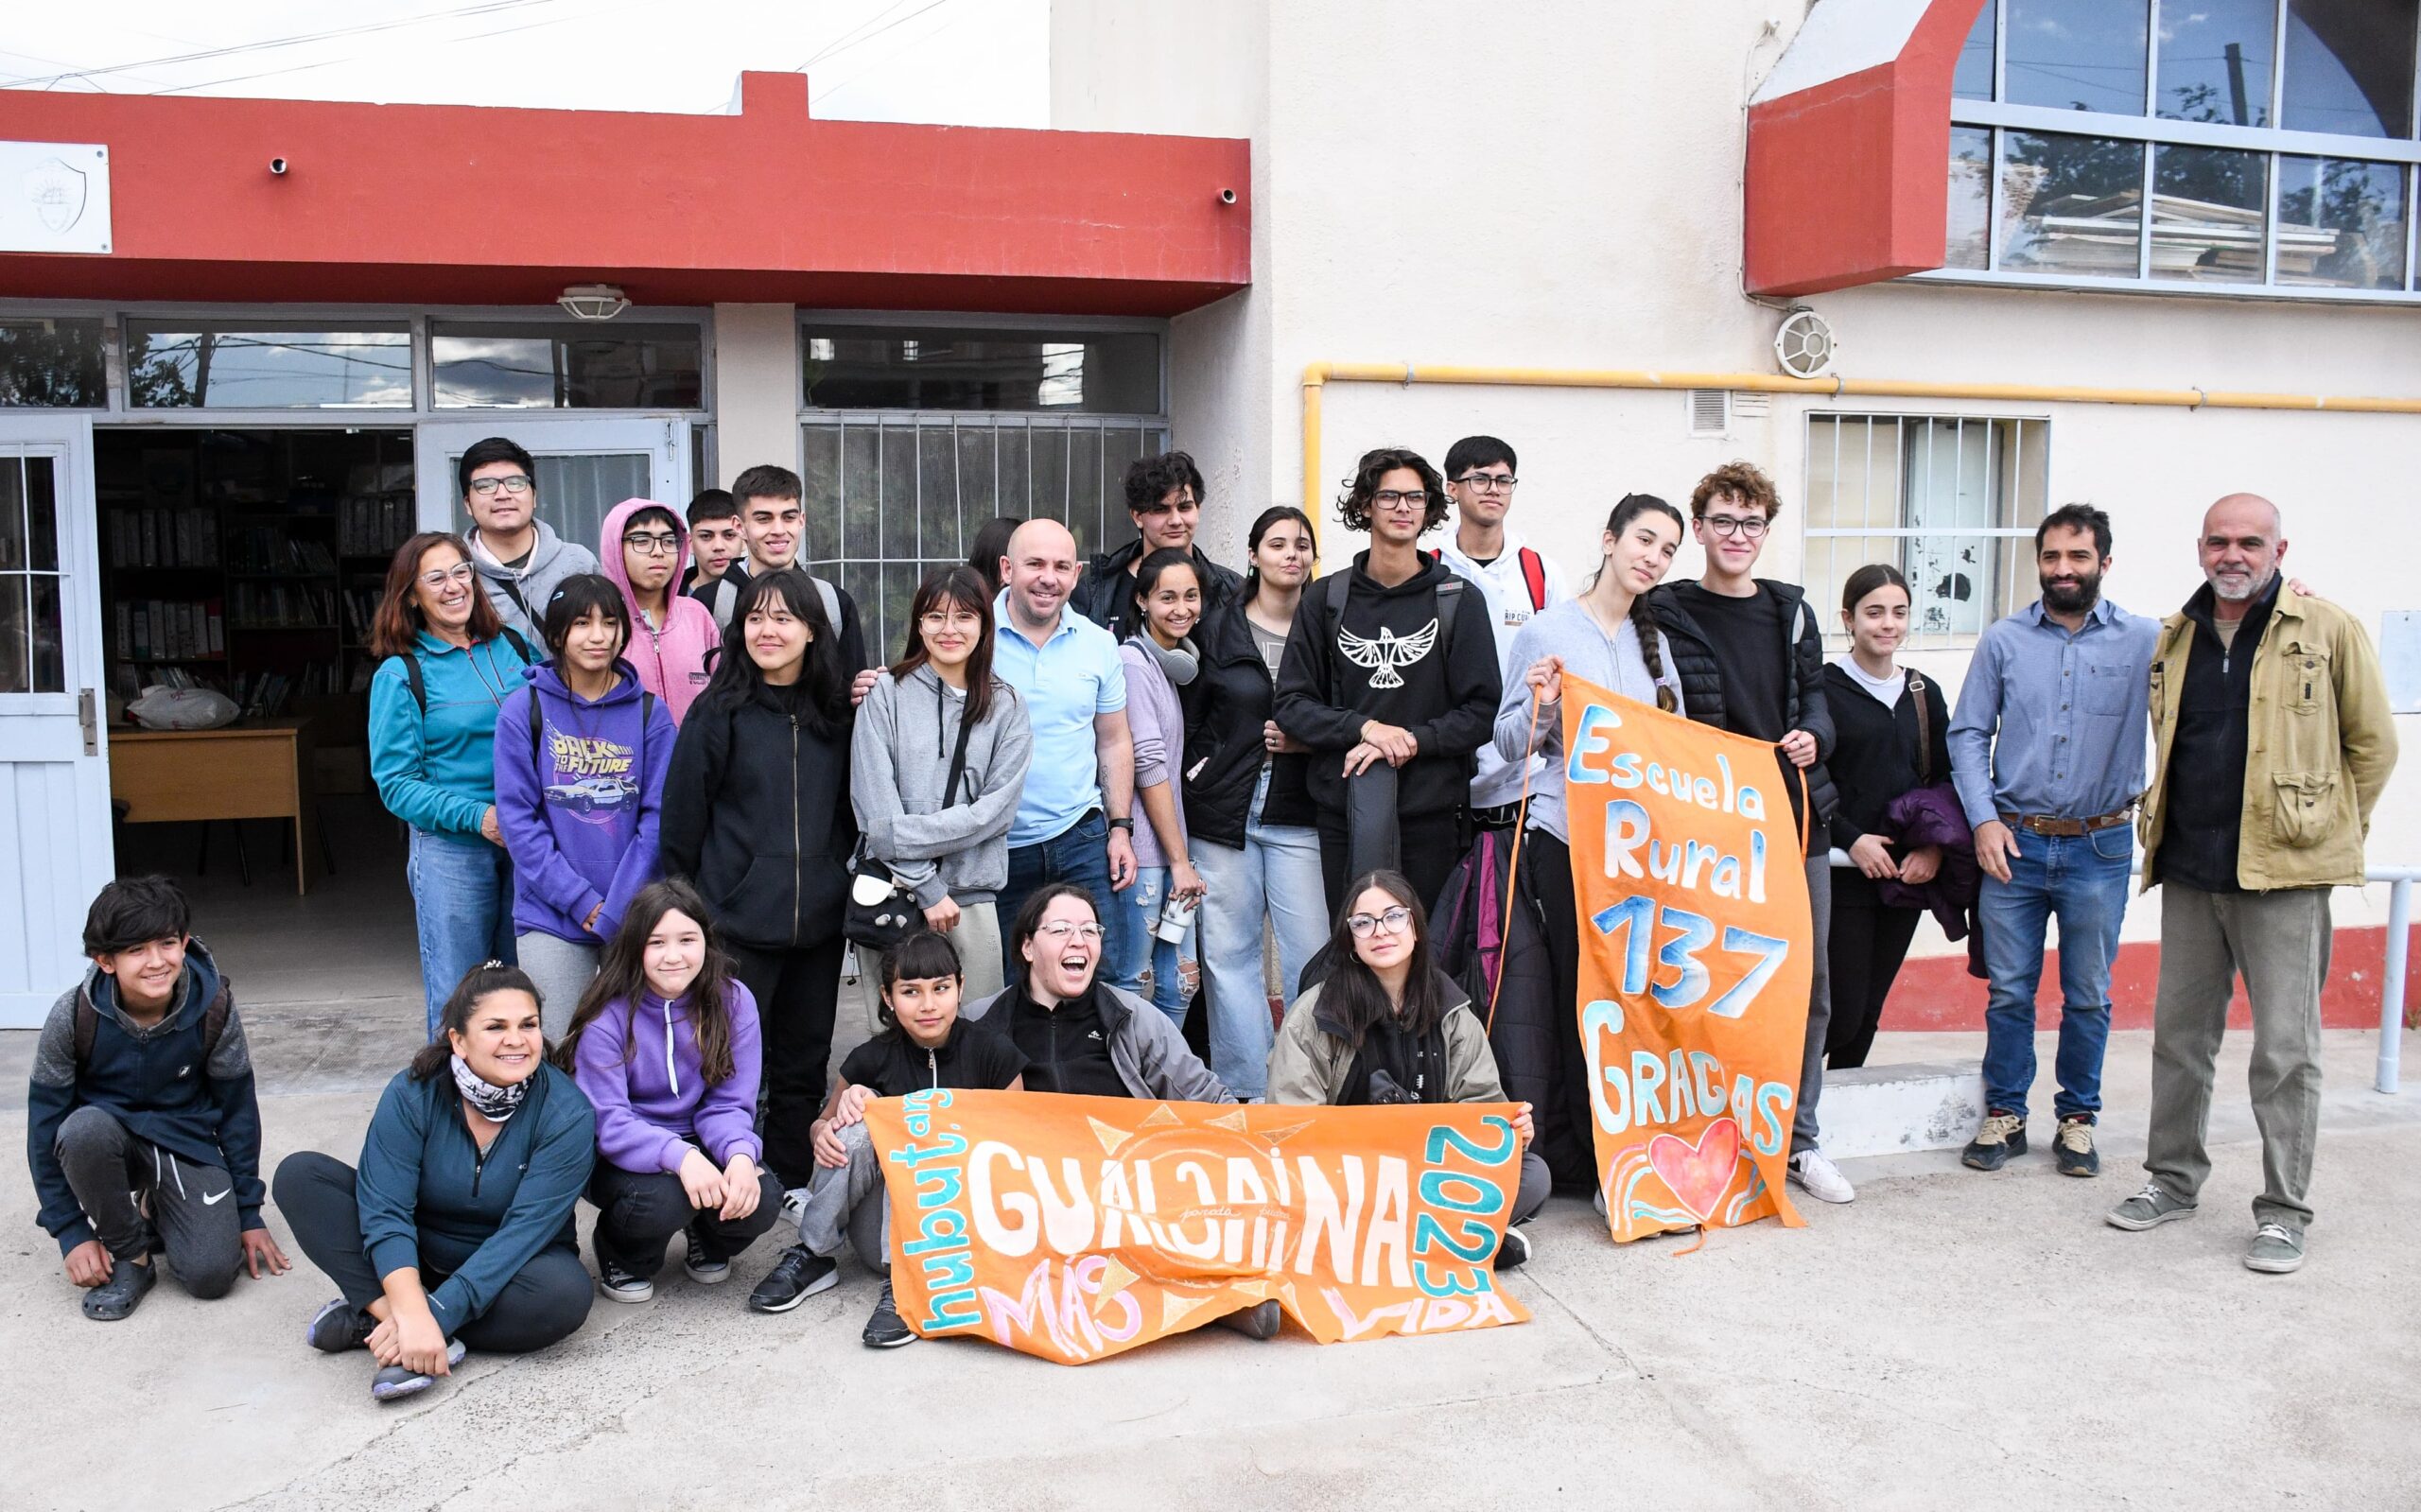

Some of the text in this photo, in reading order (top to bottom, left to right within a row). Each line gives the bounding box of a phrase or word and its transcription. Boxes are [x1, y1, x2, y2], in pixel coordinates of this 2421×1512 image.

[567, 756, 633, 775] FUTURE
[1567, 703, 1767, 822] Escuela
[1604, 798, 1767, 904] Rural
[1591, 895, 1789, 1019] 137
[1412, 1114, 1516, 1298] 2023
[1318, 1286, 1518, 1340] VIDA
